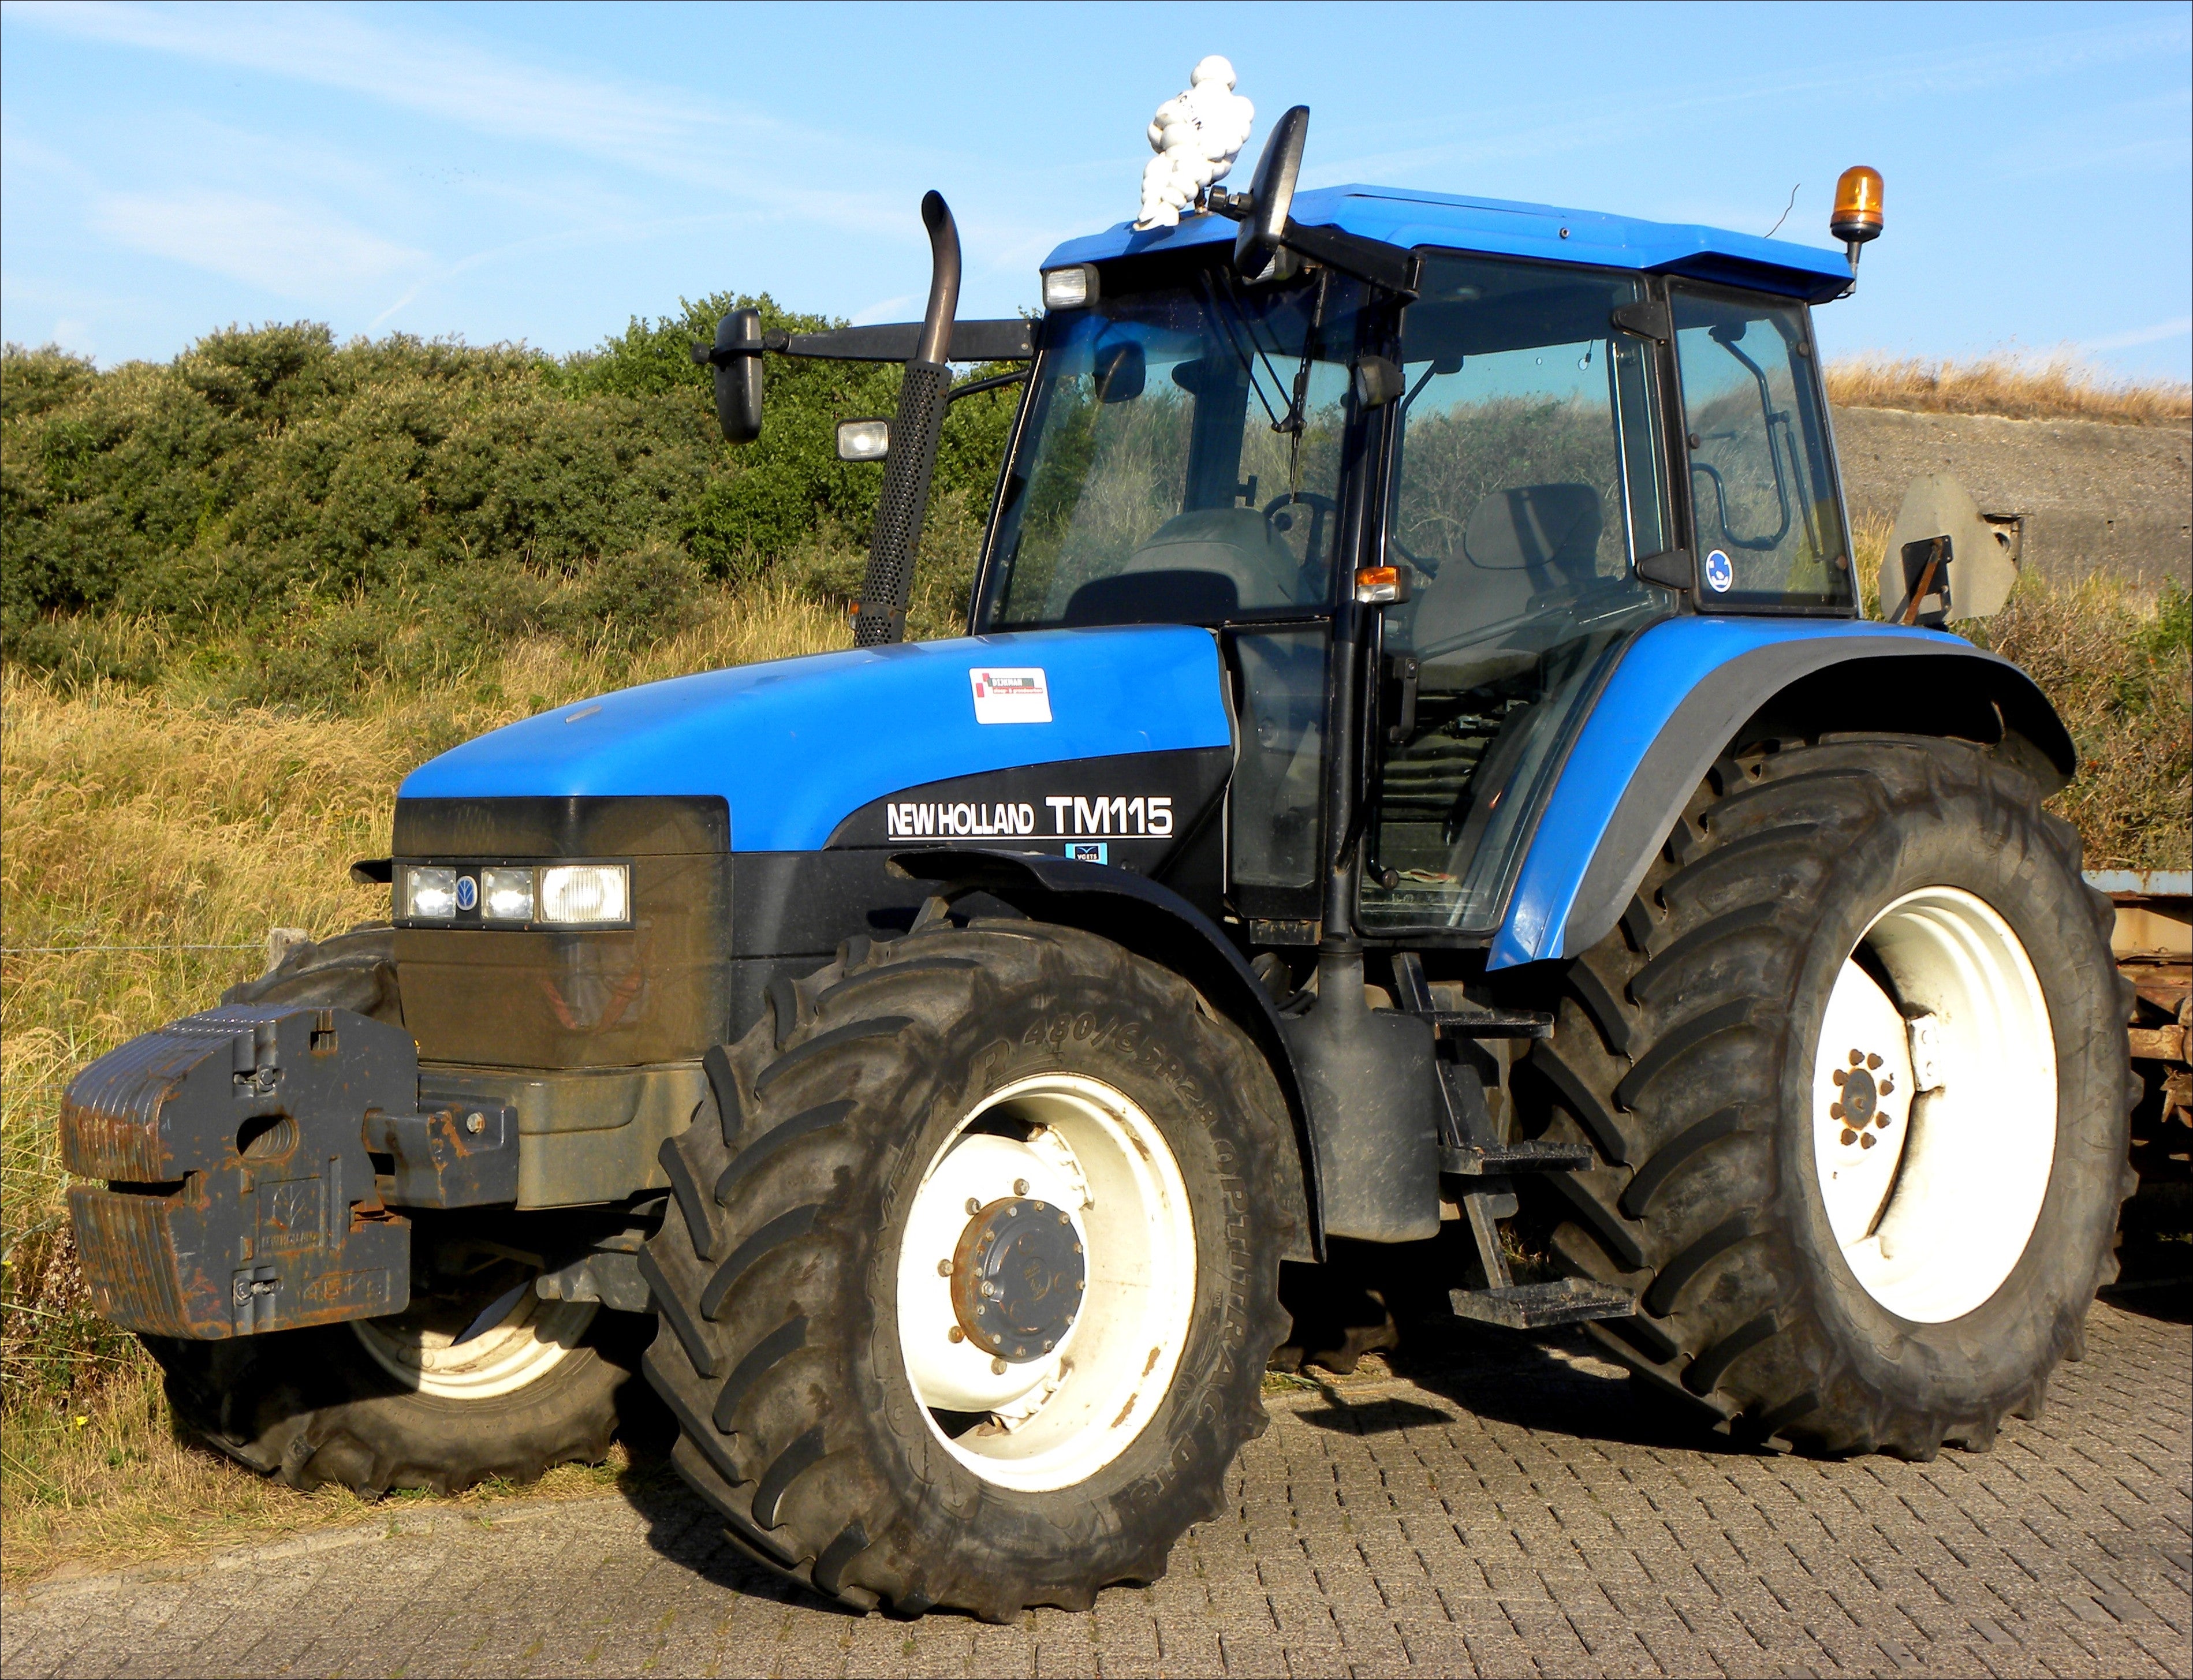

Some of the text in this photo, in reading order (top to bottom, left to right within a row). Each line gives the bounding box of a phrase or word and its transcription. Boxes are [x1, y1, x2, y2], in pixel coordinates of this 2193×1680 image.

[886, 796, 1174, 836] NEW HOLLAND TM115
